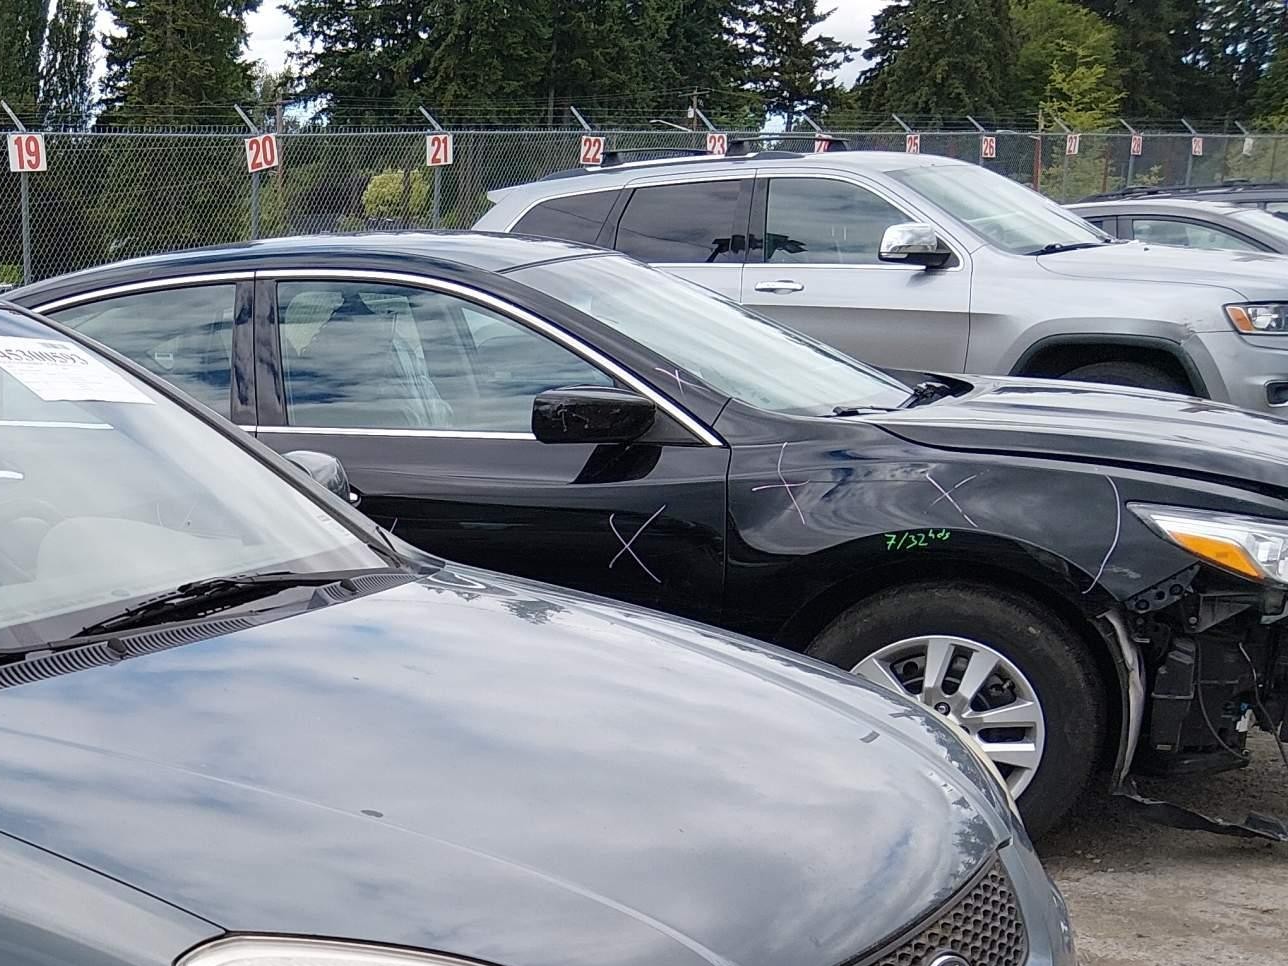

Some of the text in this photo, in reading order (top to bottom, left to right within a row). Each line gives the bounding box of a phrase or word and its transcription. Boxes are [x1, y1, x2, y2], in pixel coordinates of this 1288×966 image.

[15, 135, 41, 170] 19
[249, 135, 275, 171] 20
[431, 136, 449, 164] 21
[583, 138, 602, 163] 22
[709, 135, 726, 155] 23
[908, 136, 919, 153] 25
[983, 137, 994, 156] 26
[1067, 135, 1078, 154] 27
